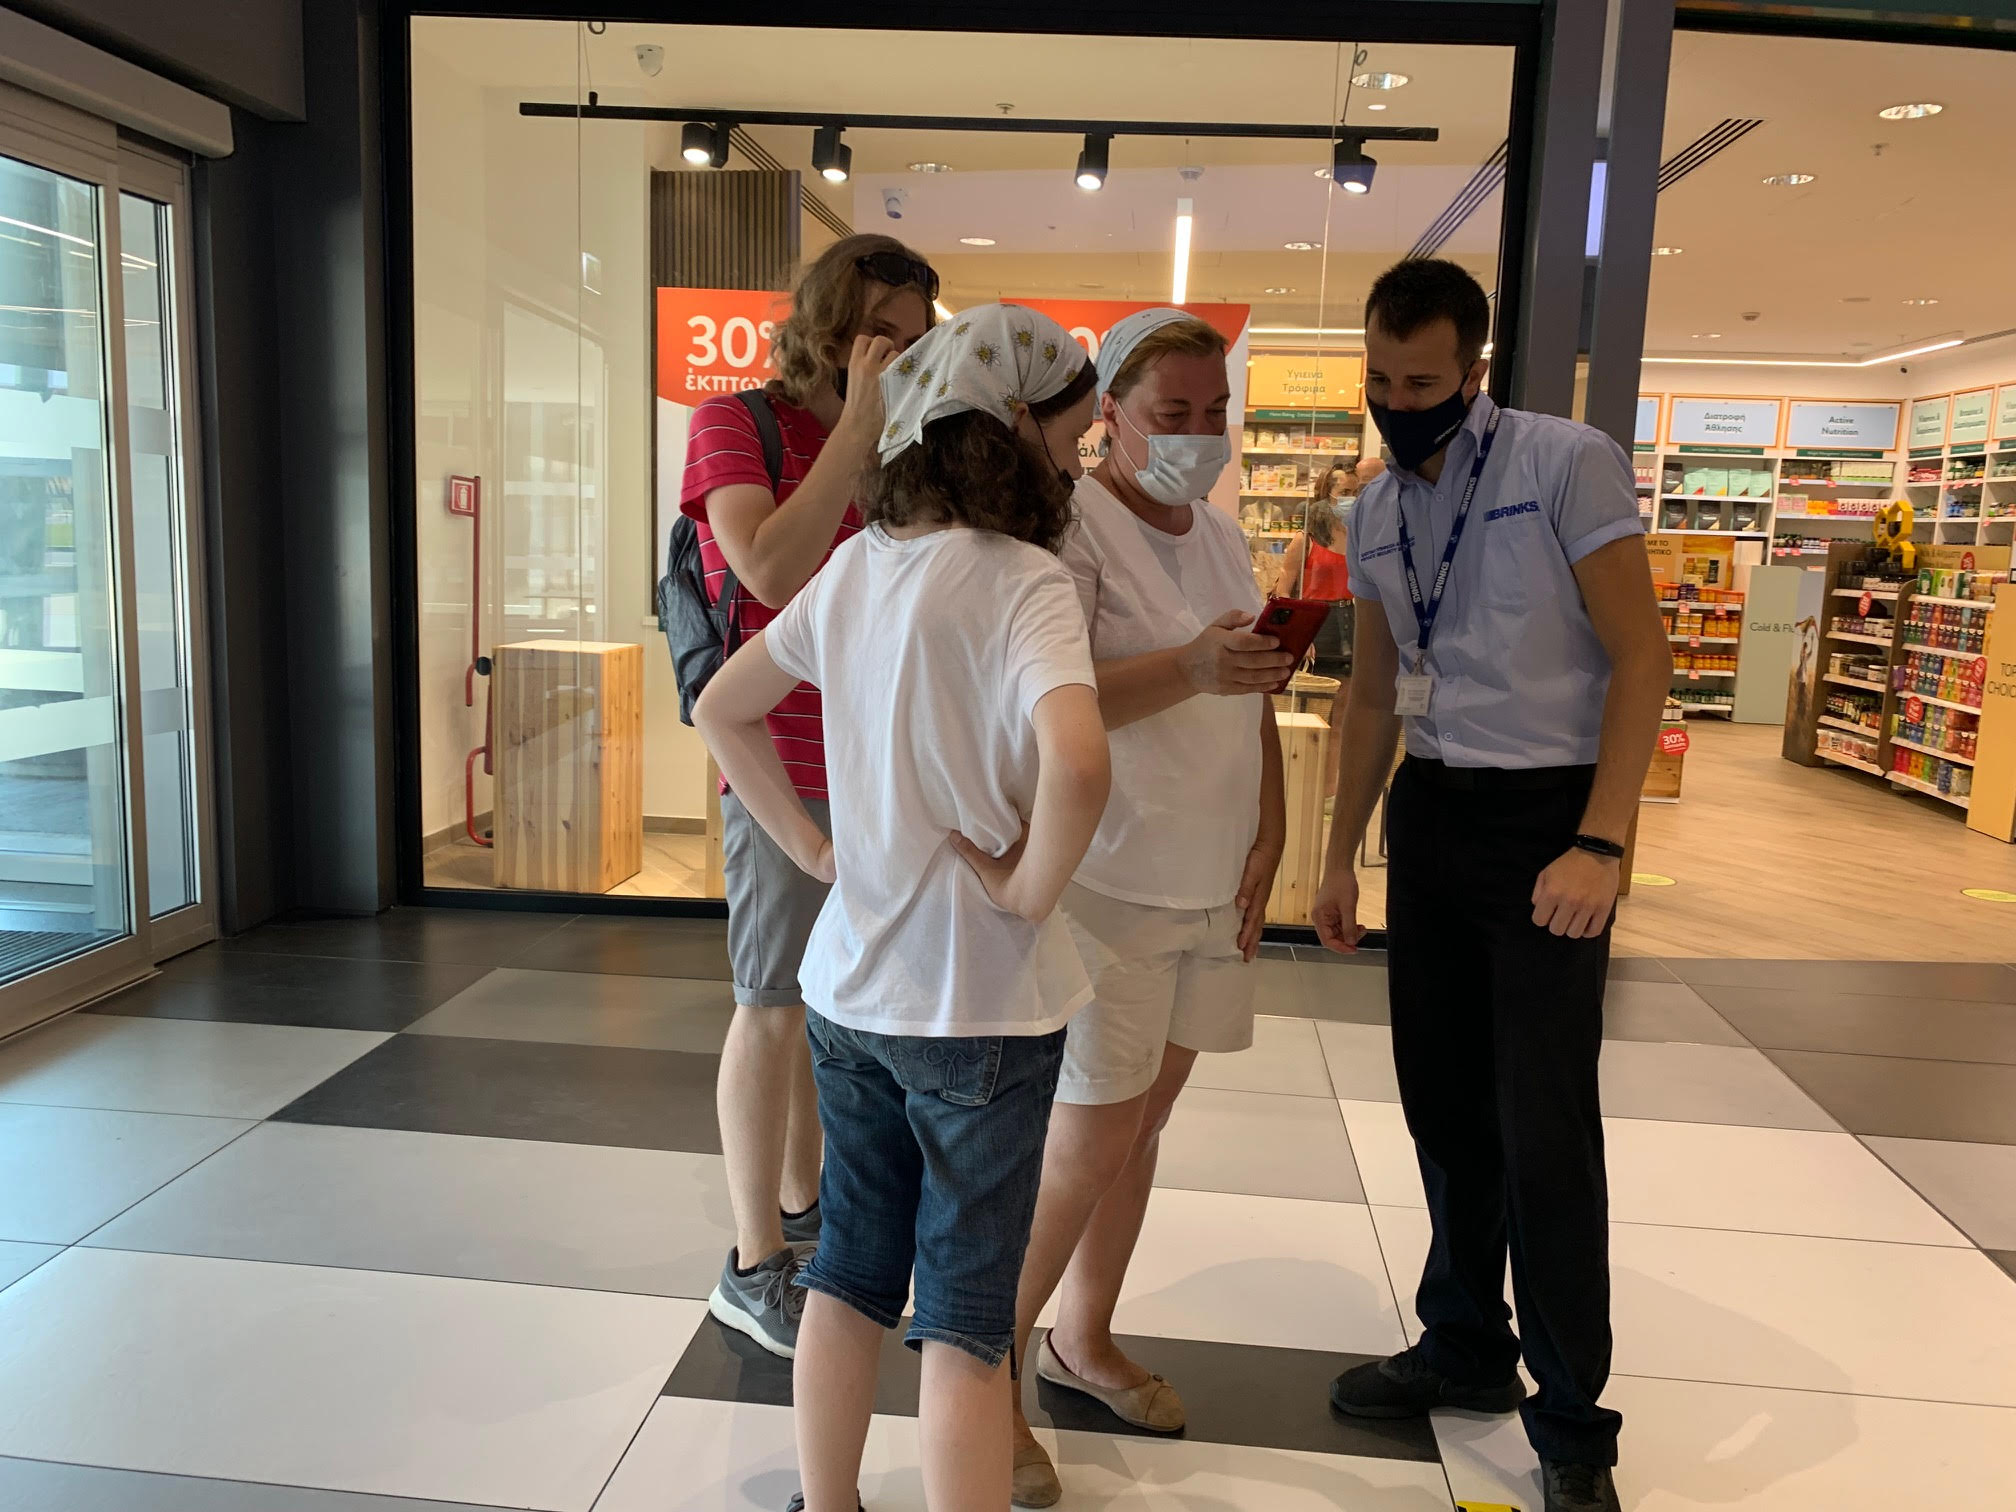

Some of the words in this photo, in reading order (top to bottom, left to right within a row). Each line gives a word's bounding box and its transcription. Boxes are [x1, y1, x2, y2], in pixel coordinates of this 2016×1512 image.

[1828, 415, 1855, 424] Active
[1821, 427, 1859, 436] Nutrition
[1460, 477, 1477, 512] BRINKS
[1489, 500, 1539, 520] BRINKS
[1435, 561, 1450, 598] BRINKS
[1750, 622, 1771, 632] Cold
[1773, 624, 1781, 632] &
[1987, 681, 2016, 698] CHOIC
[1662, 733, 1686, 745] 30%
